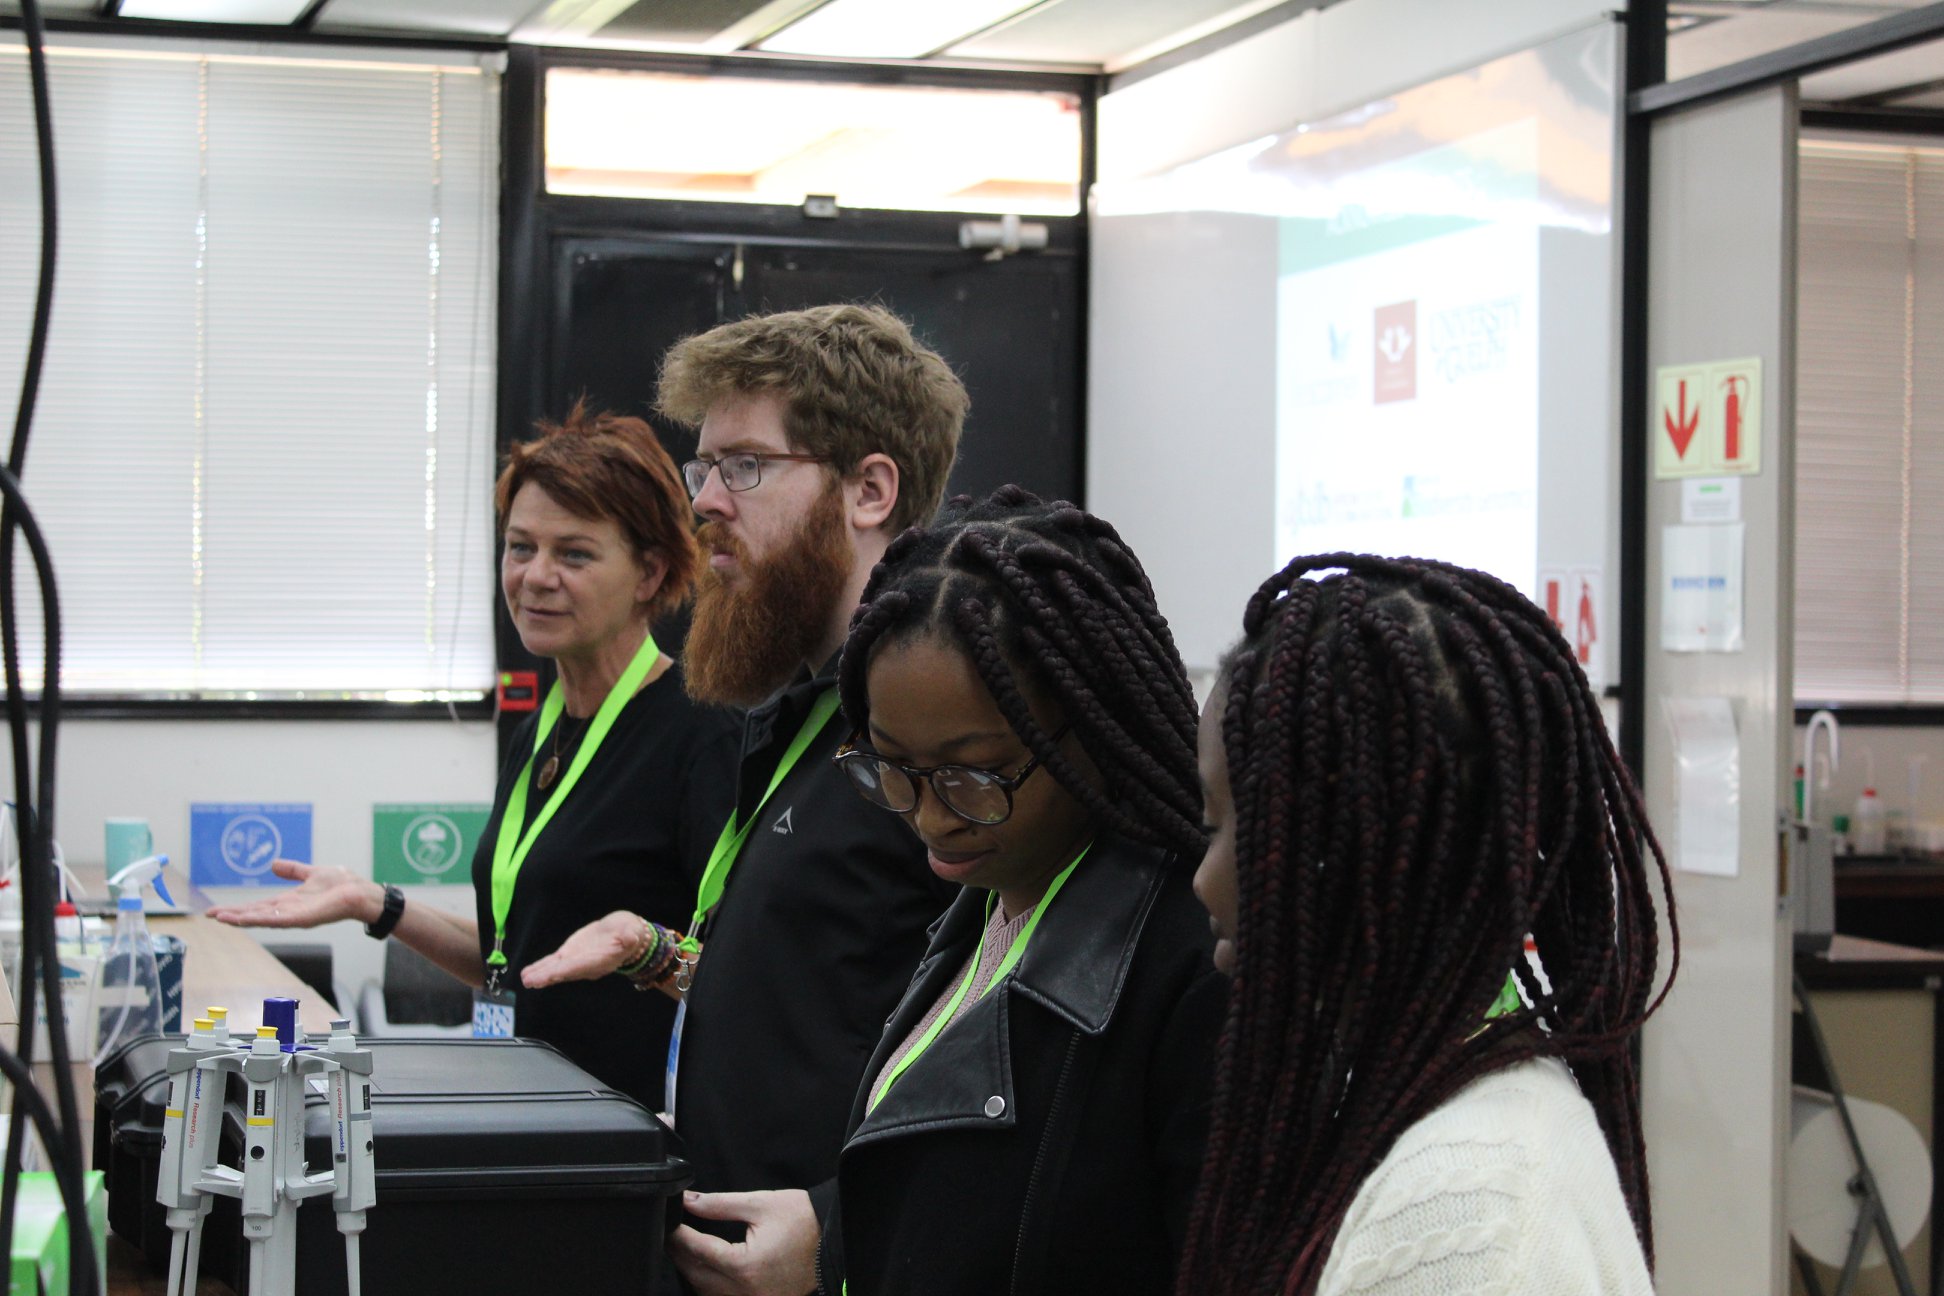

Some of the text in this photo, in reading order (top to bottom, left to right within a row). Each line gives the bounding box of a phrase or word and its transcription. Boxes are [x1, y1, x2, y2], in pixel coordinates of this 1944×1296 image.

[190, 1102, 200, 1134] Research
[336, 1087, 344, 1119] Research
[337, 1120, 346, 1152] eppendorf
